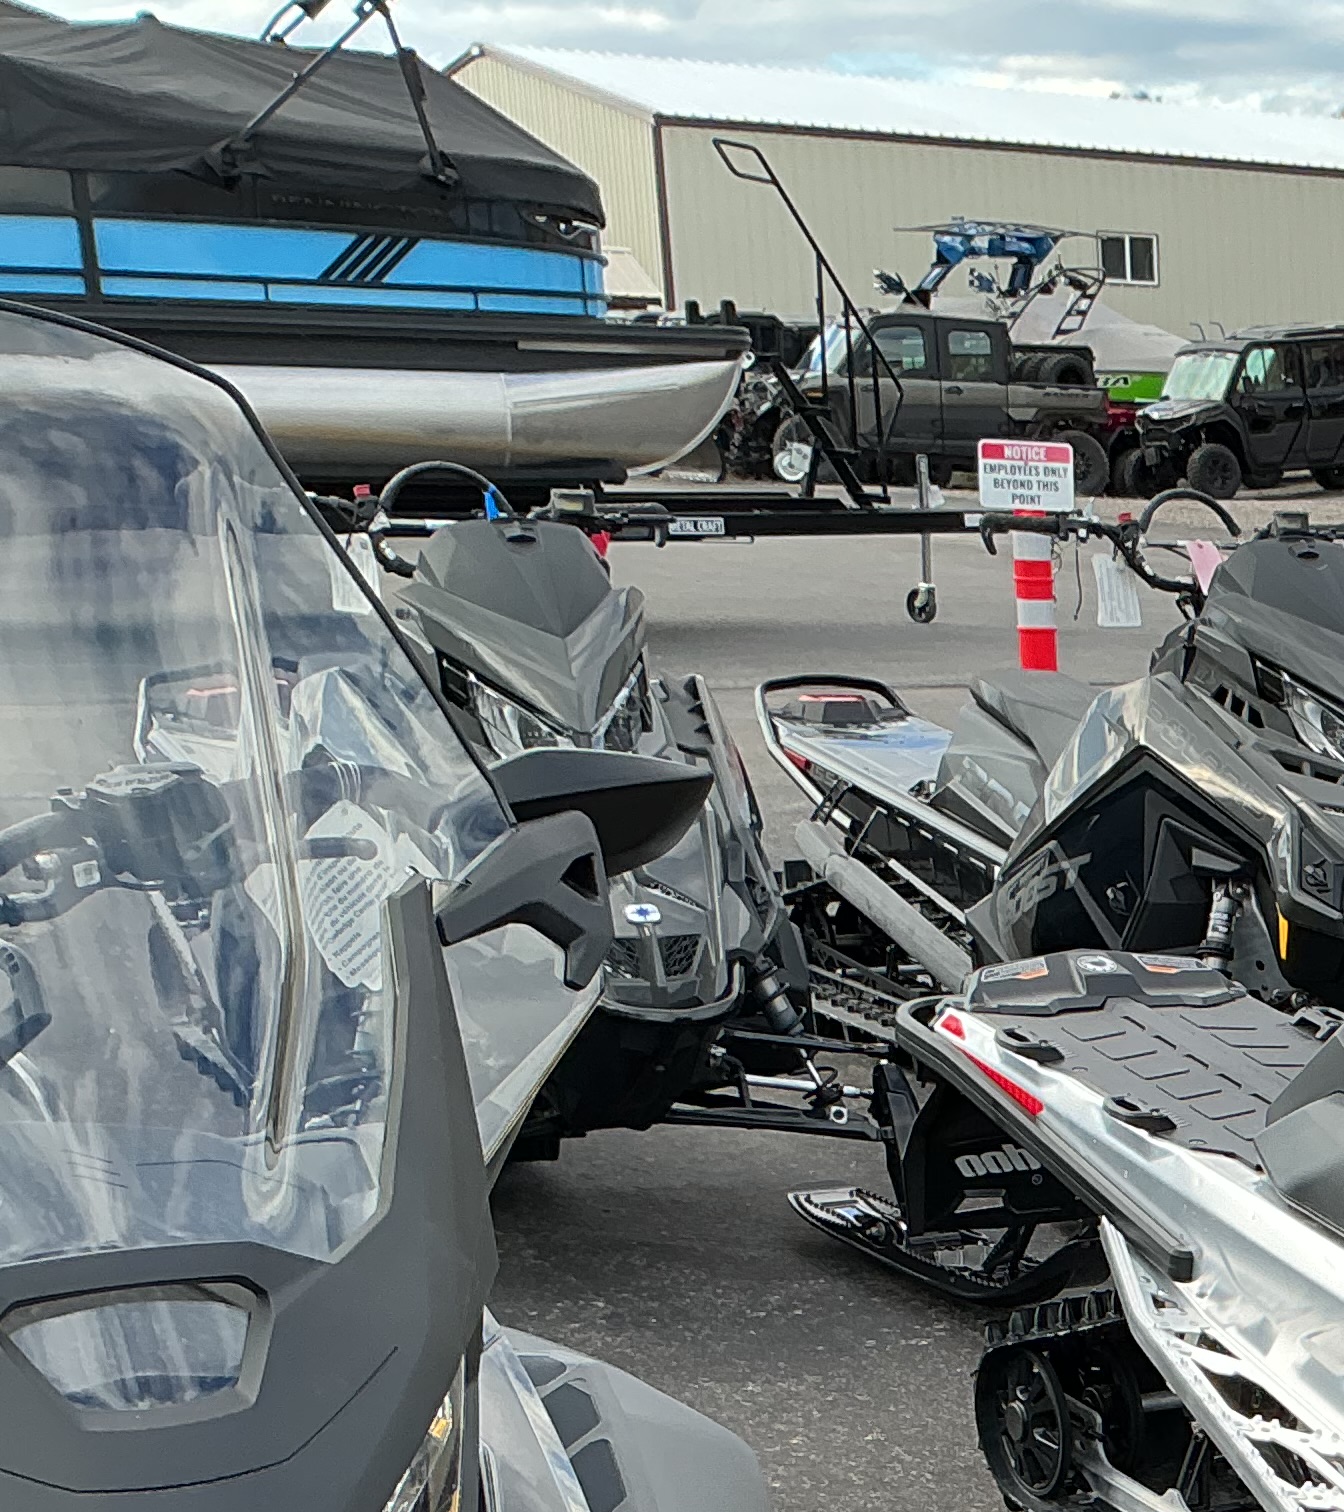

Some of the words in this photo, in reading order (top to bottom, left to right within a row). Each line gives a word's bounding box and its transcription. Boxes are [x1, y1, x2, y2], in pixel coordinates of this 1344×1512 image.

[1004, 445, 1046, 461] NOTICE
[983, 462, 1040, 477] EMPLOYEES
[1043, 466, 1068, 478] ONLY
[993, 478, 1033, 490] BEYOND
[1036, 479, 1059, 492] THIS
[1011, 493, 1041, 505] POINT
